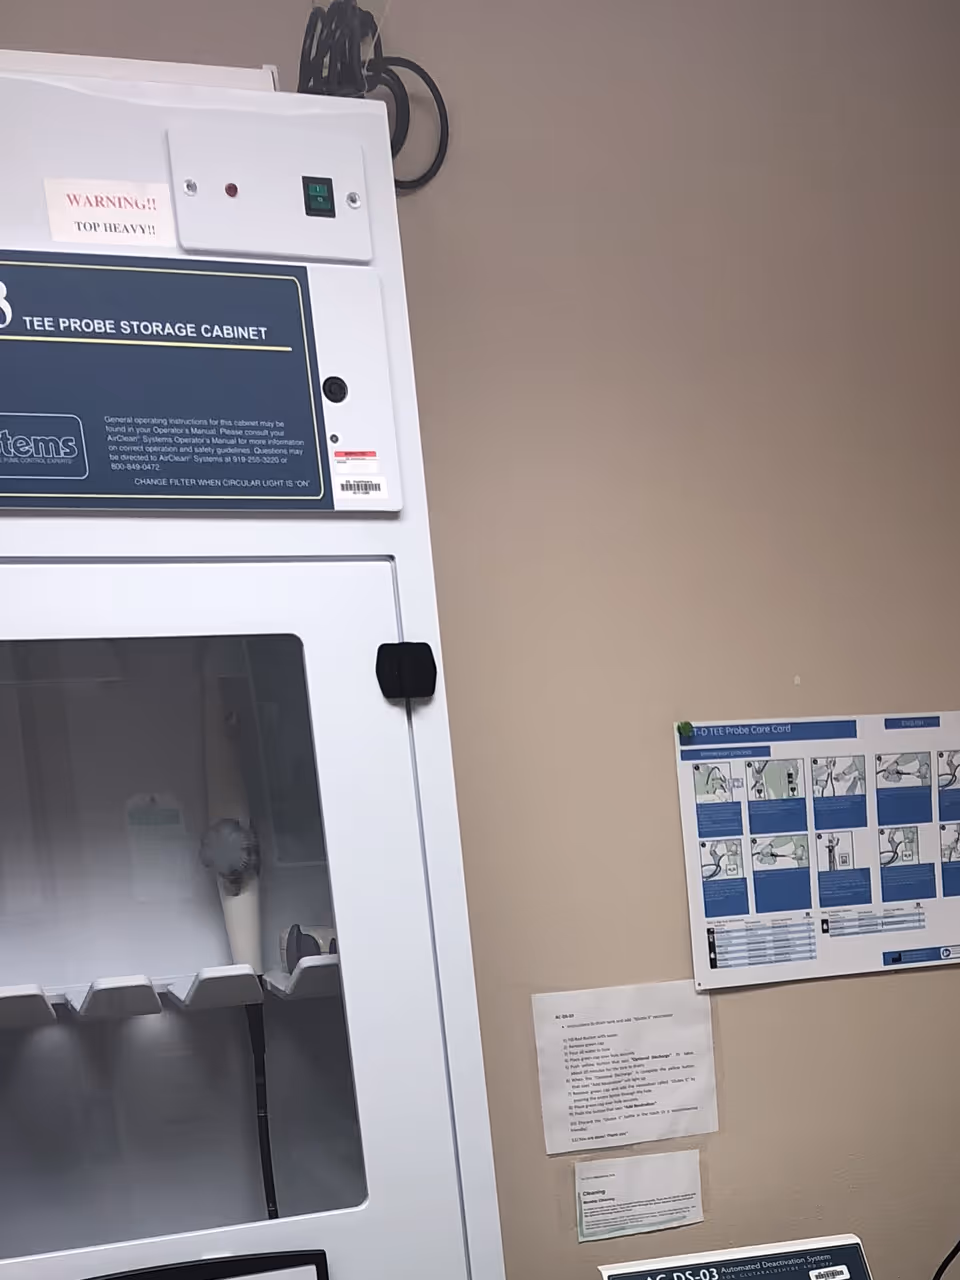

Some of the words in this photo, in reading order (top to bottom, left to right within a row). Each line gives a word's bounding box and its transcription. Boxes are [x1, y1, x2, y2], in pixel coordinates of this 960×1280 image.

[66, 192, 157, 211] WARNING!!
[74, 220, 101, 233] TOP
[103, 222, 156, 236] HEAVY!!
[22, 315, 55, 331] TEE
[59, 318, 116, 334] PROBE
[120, 320, 197, 338] STORAGE
[200, 323, 268, 340] CABINET
[104, 416, 133, 424] General
[134, 417, 168, 426] operating
[210, 418, 220, 426] for
[276, 420, 284, 428] be
[0, 429, 78, 458] tems
[142, 436, 172, 444] Systems
[194, 455, 223, 464] Systems
[134, 478, 168, 486] CHANGE
[170, 478, 197, 486] FILTER
[262, 480, 284, 488] LIGHT
[286, 480, 294, 488] IS
[690, 727, 708, 736] T-D
[710, 726, 725, 736] TEE
[726, 725, 750, 736] Probe
[750, 724, 771, 734] Care
[772, 724, 792, 734] Card
[720, 1262, 761, 1274] Automated
[762, 1258, 806, 1270] Deactivation
[806, 1254, 832, 1266] System
